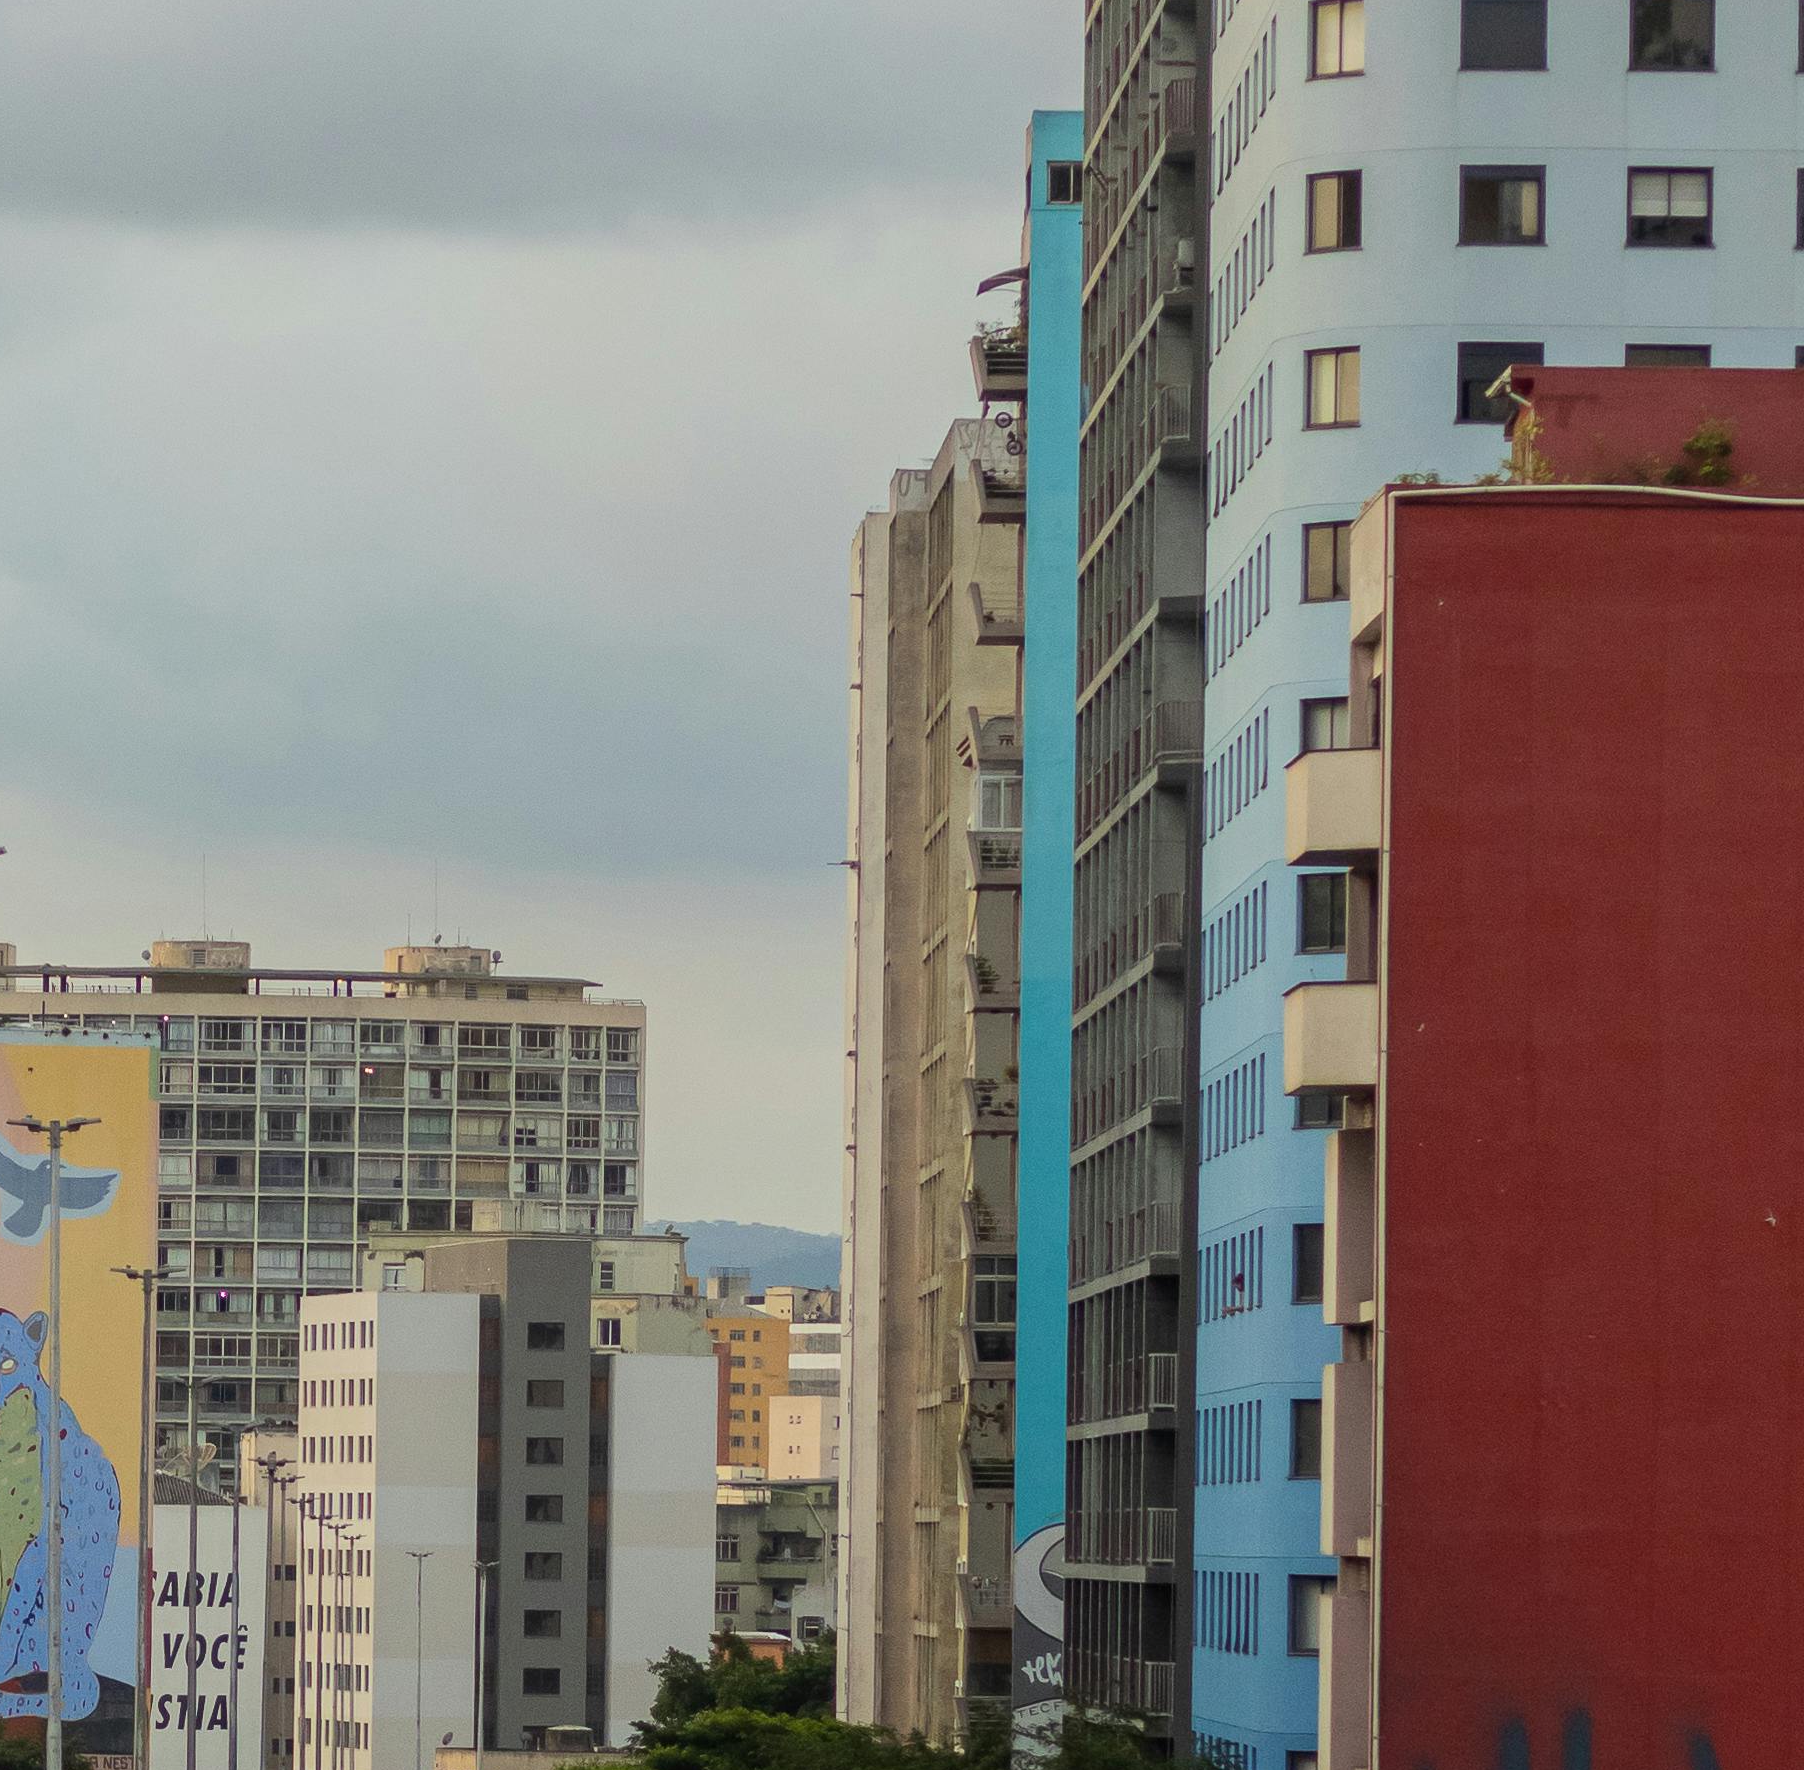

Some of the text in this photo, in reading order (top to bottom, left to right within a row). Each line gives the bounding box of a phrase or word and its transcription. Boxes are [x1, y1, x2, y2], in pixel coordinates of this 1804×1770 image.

[152, 1570, 240, 1607] ABIA
[163, 1625, 248, 1670] VOCÊ
[150, 1693, 229, 1731] STIA
